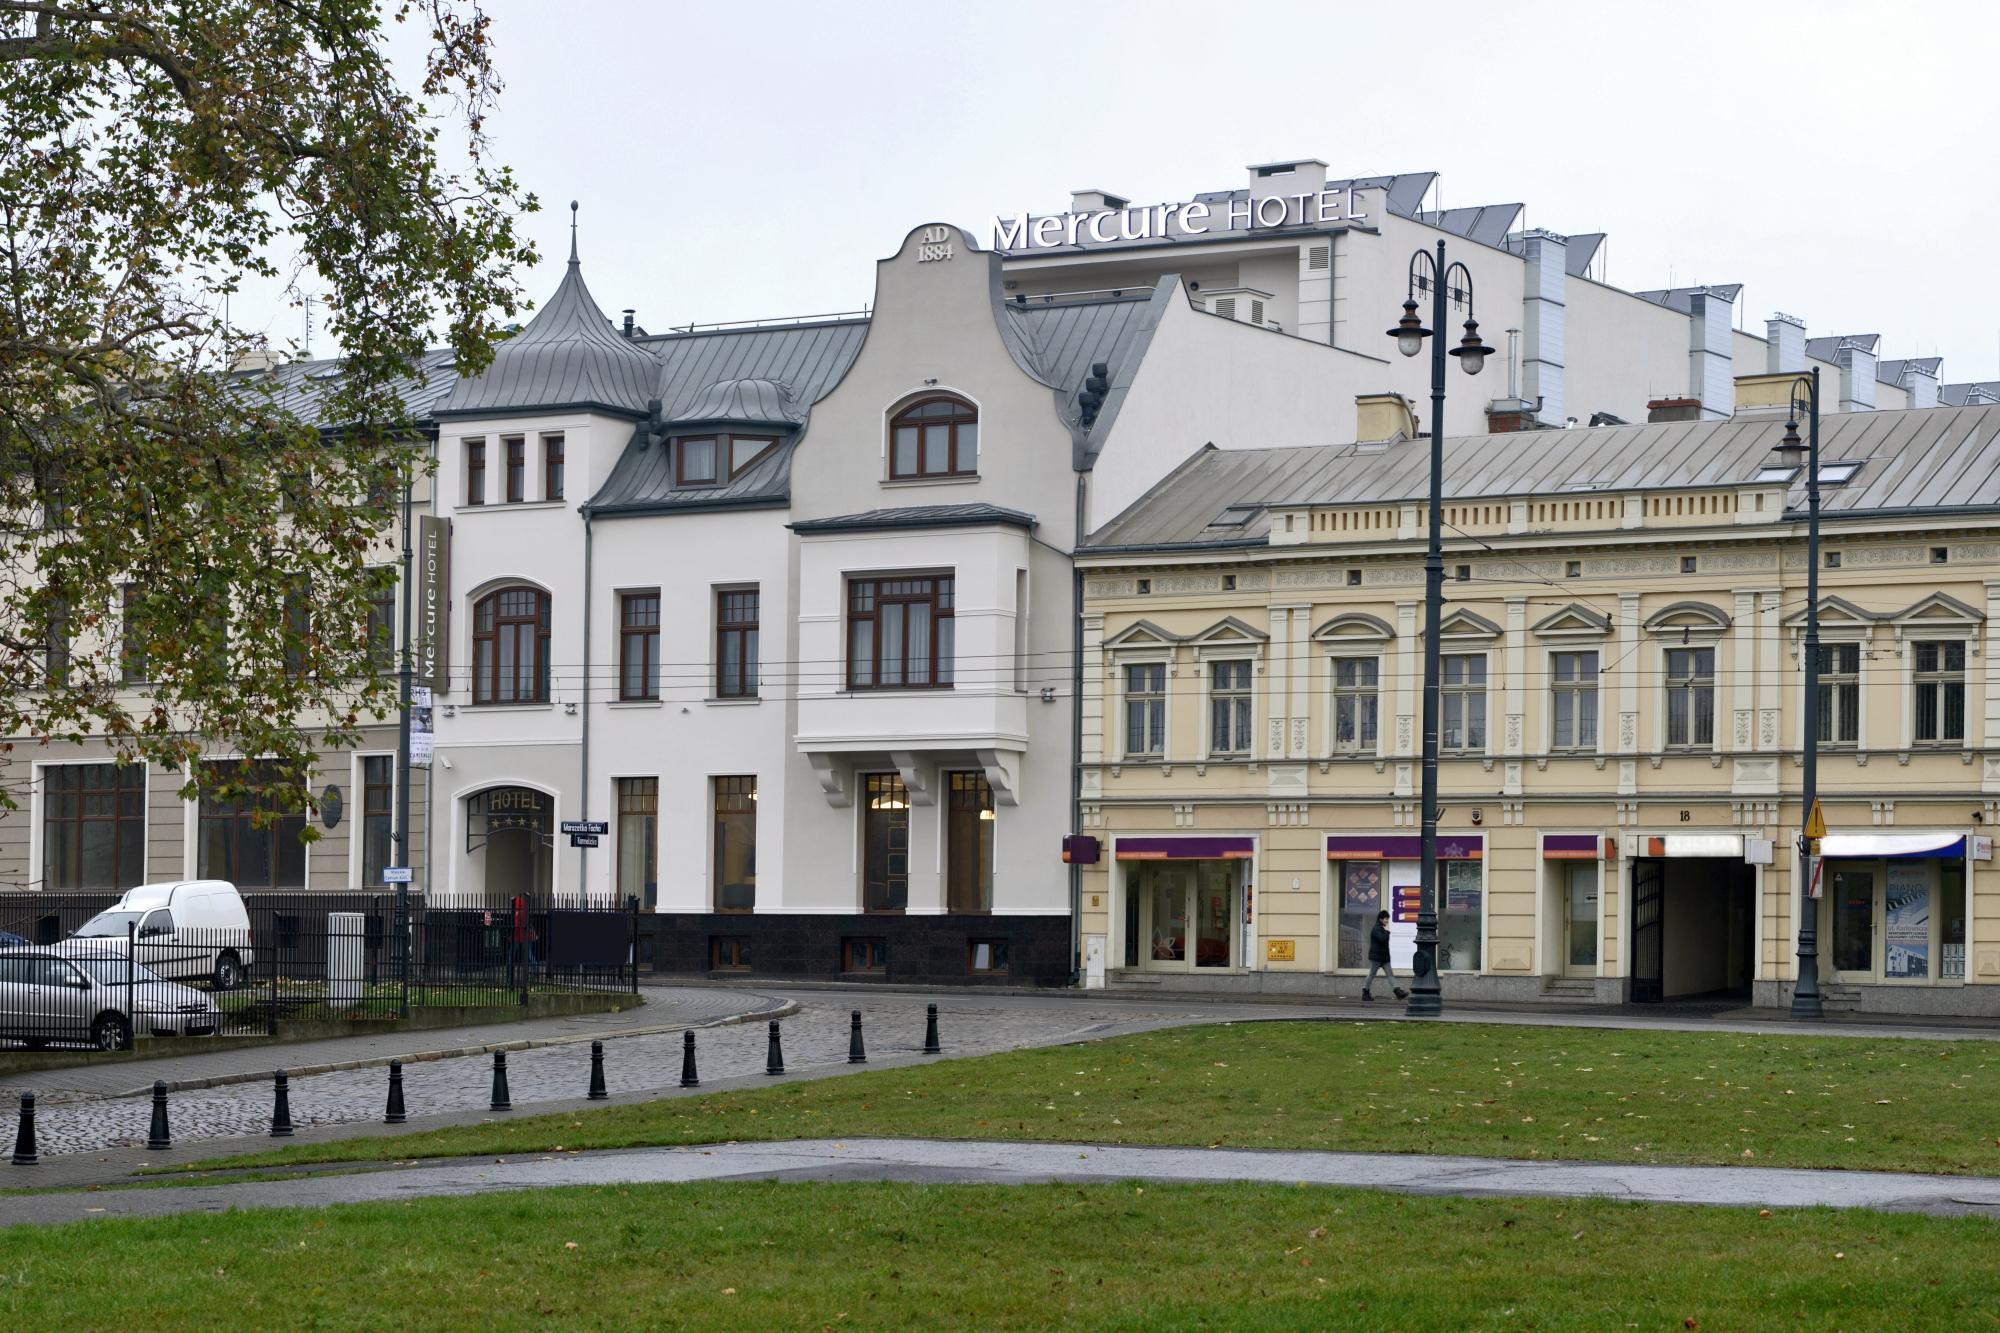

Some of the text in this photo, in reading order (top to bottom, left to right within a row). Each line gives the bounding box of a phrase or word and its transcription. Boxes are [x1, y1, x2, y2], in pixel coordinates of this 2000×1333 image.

[987, 187, 1368, 251] Mercure HOTEL
[920, 226, 949, 244] AD
[918, 243, 953, 262] 1884
[424, 530, 437, 678] Mercure HOTEL
[490, 791, 542, 811] HOTEL
[1680, 810, 1690, 822] 18
